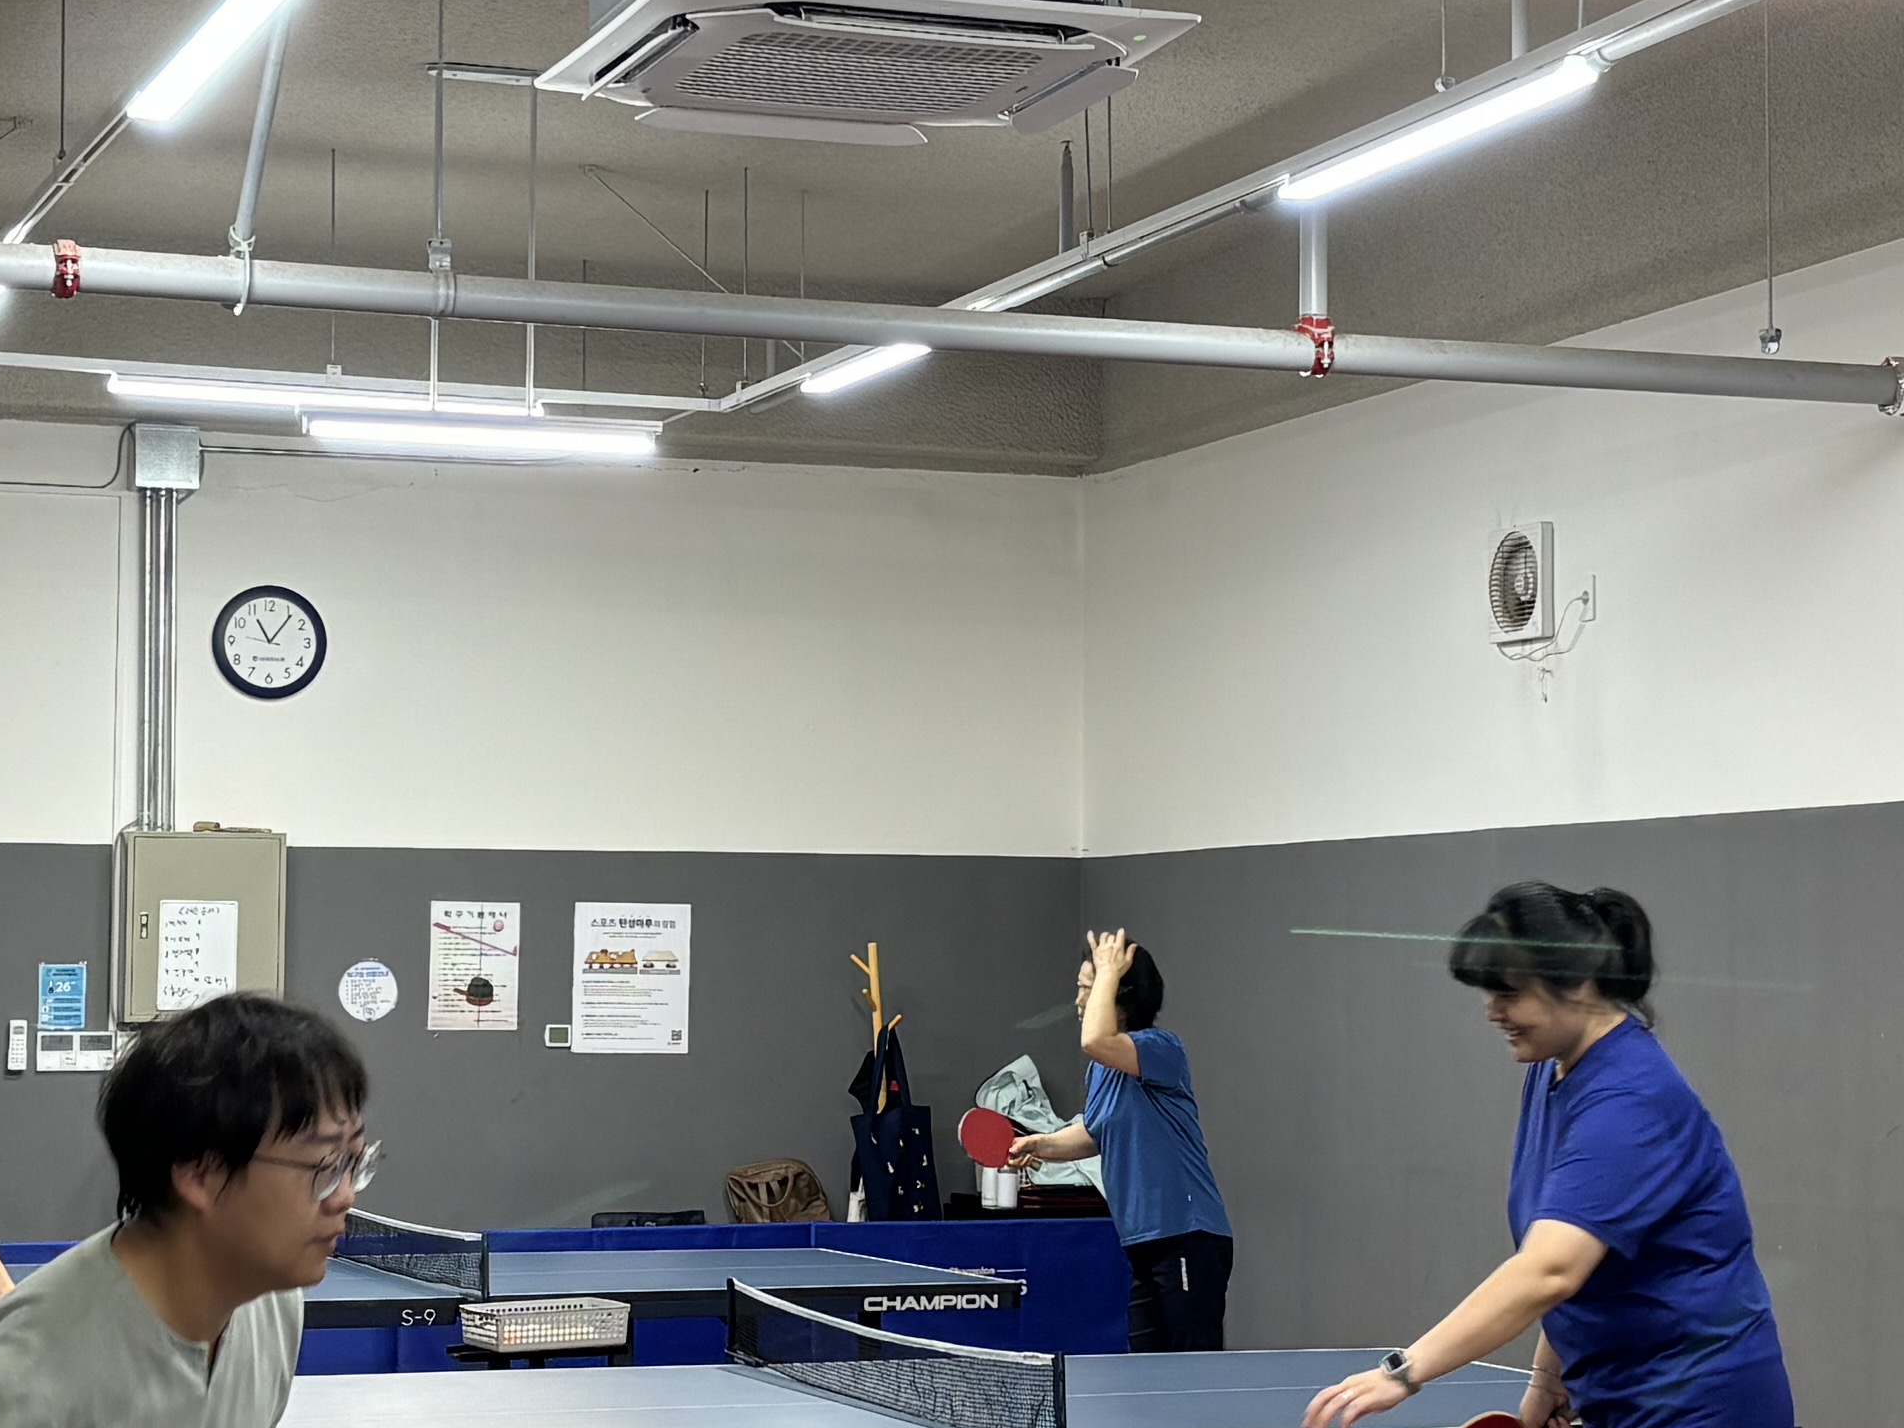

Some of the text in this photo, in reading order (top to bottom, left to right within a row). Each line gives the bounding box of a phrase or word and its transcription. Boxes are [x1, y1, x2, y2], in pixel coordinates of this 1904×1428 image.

[248, 603, 257, 616] 11
[264, 599, 276, 612] 12
[234, 616, 246, 629] 10
[298, 619, 306, 631] 2
[227, 635, 236, 646] 9
[303, 637, 312, 649] 3
[233, 654, 241, 666] 8
[296, 656, 304, 668] 4
[248, 667, 256, 679] 7
[265, 672, 274, 685] 6
[283, 667, 292, 679] 5
[863, 1294, 999, 1311] CHAMPION
[401, 1308, 437, 1326] S-9
